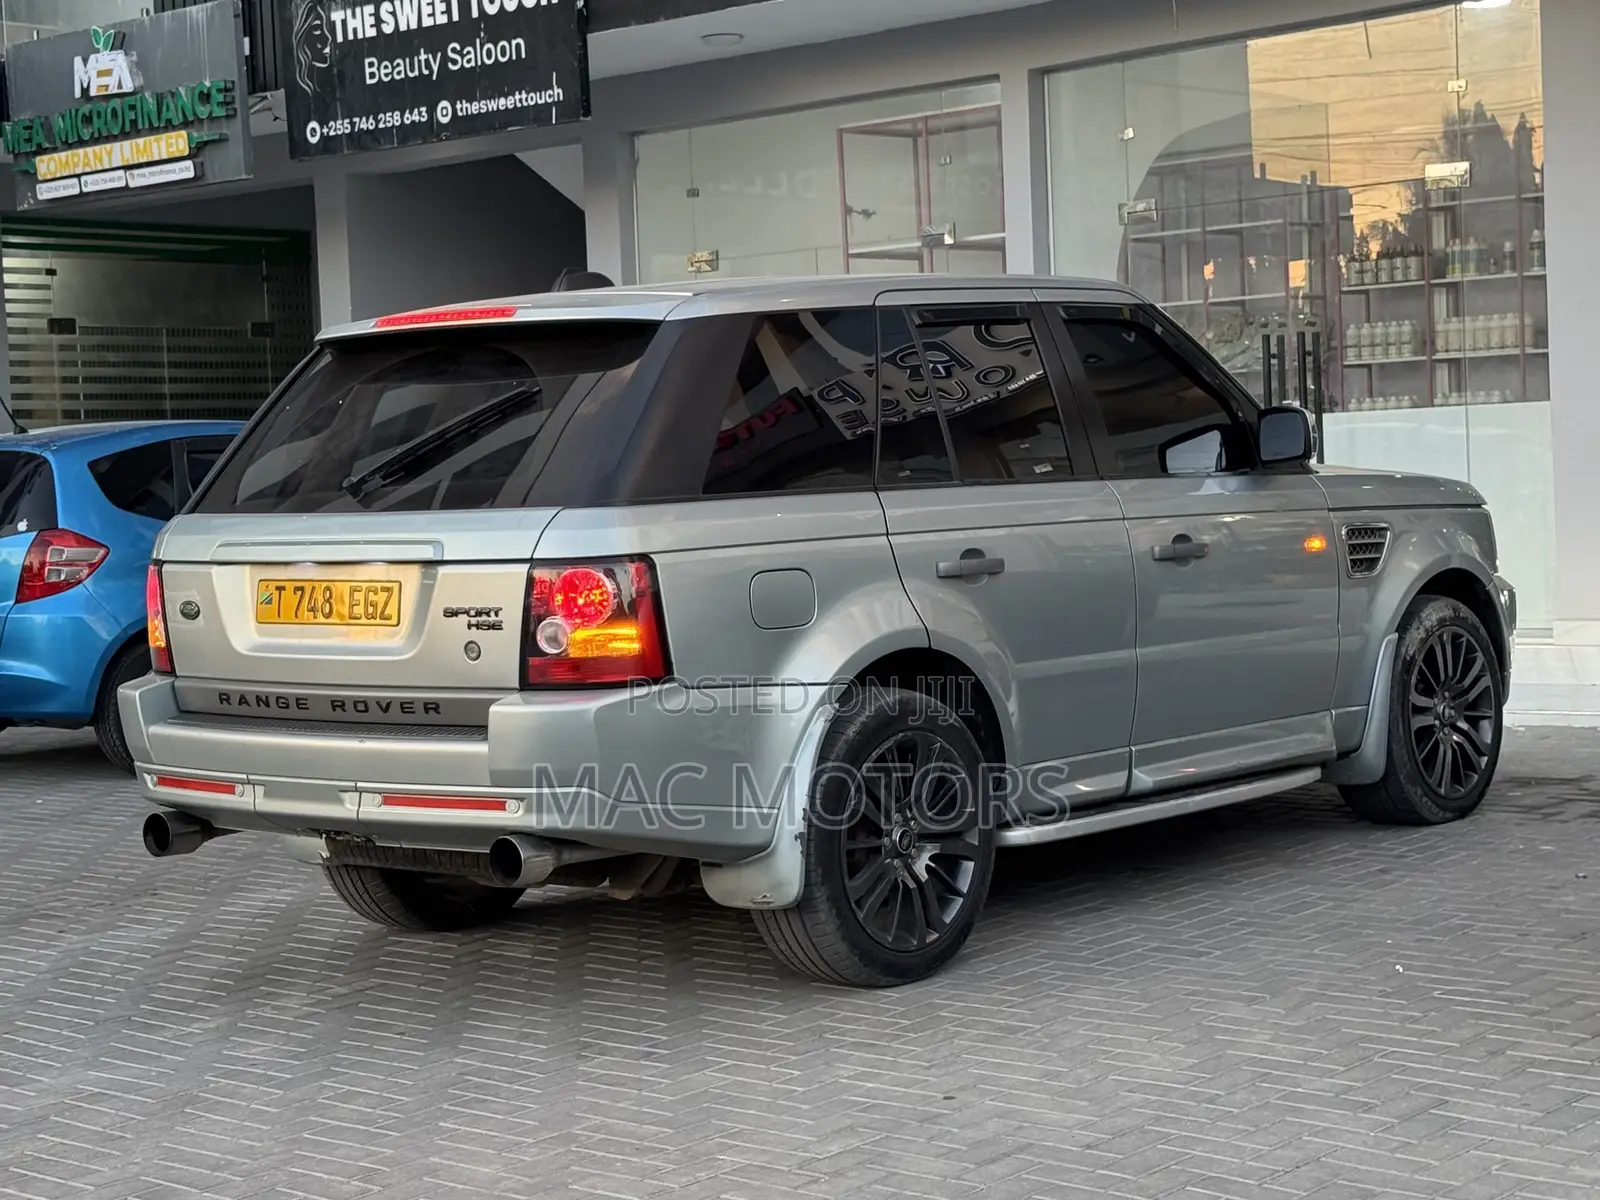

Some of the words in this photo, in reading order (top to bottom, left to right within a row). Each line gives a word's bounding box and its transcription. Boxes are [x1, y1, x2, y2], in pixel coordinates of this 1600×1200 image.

[331, 4, 377, 43] THE
[73, 49, 135, 99] MEA
[364, 48, 441, 85] Beauty
[447, 37, 526, 71] Saloon
[2, 117, 46, 153] MEA
[54, 80, 229, 143] MICROFINANCE
[321, 117, 351, 137] +255
[352, 113, 376, 133] 746
[377, 110, 402, 128] 258
[404, 106, 428, 125] 643
[456, 85, 563, 117] thesweettouch
[37, 147, 119, 178] COMPANY
[120, 133, 187, 165] LIMITED
[275, 586, 286, 620] T
[294, 585, 333, 620] 748
[349, 587, 394, 621] EGZ
[442, 606, 503, 619] SPORT
[466, 620, 504, 631] HSE
[218, 692, 311, 711] RANGE
[331, 698, 442, 716] ROVER
